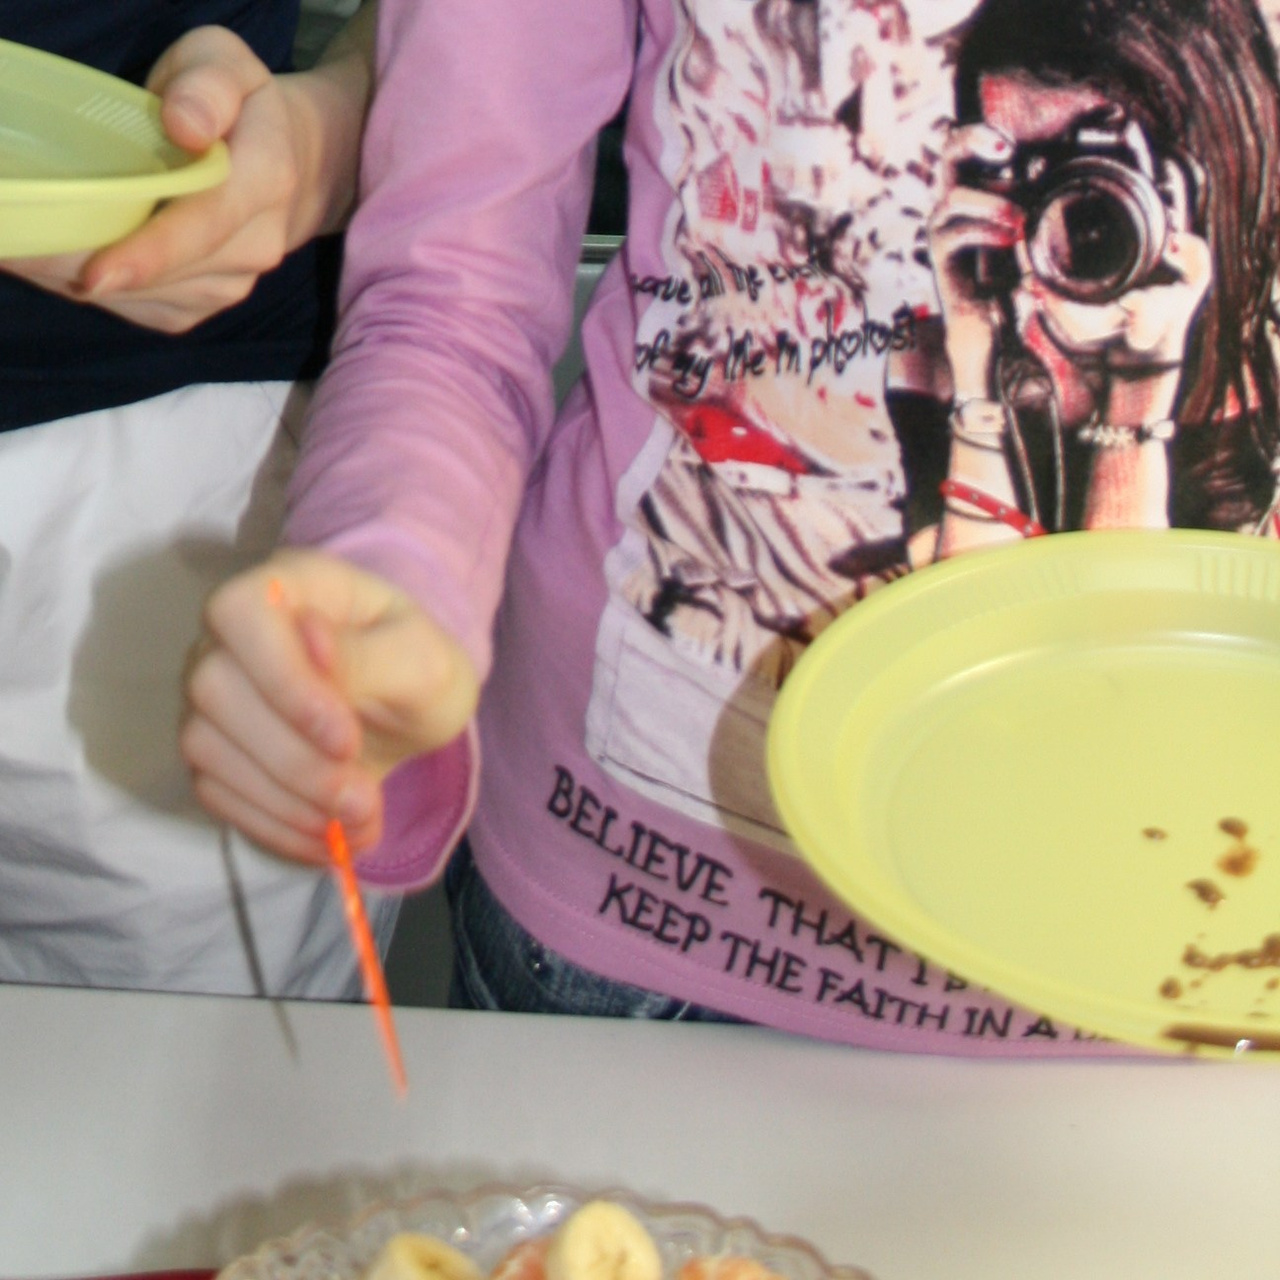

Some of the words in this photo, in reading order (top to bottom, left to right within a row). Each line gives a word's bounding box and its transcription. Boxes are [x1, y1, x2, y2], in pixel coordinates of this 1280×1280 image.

[635, 329, 671, 373] of
[546, 764, 734, 907] BELIEVE
[758, 886, 902, 973] THAT
[598, 872, 712, 953] KEEP
[720, 928, 808, 994] THE
[816, 966, 952, 1032] FAITH
[962, 1004, 1014, 1039] IN
[1022, 1014, 1059, 1040] A
